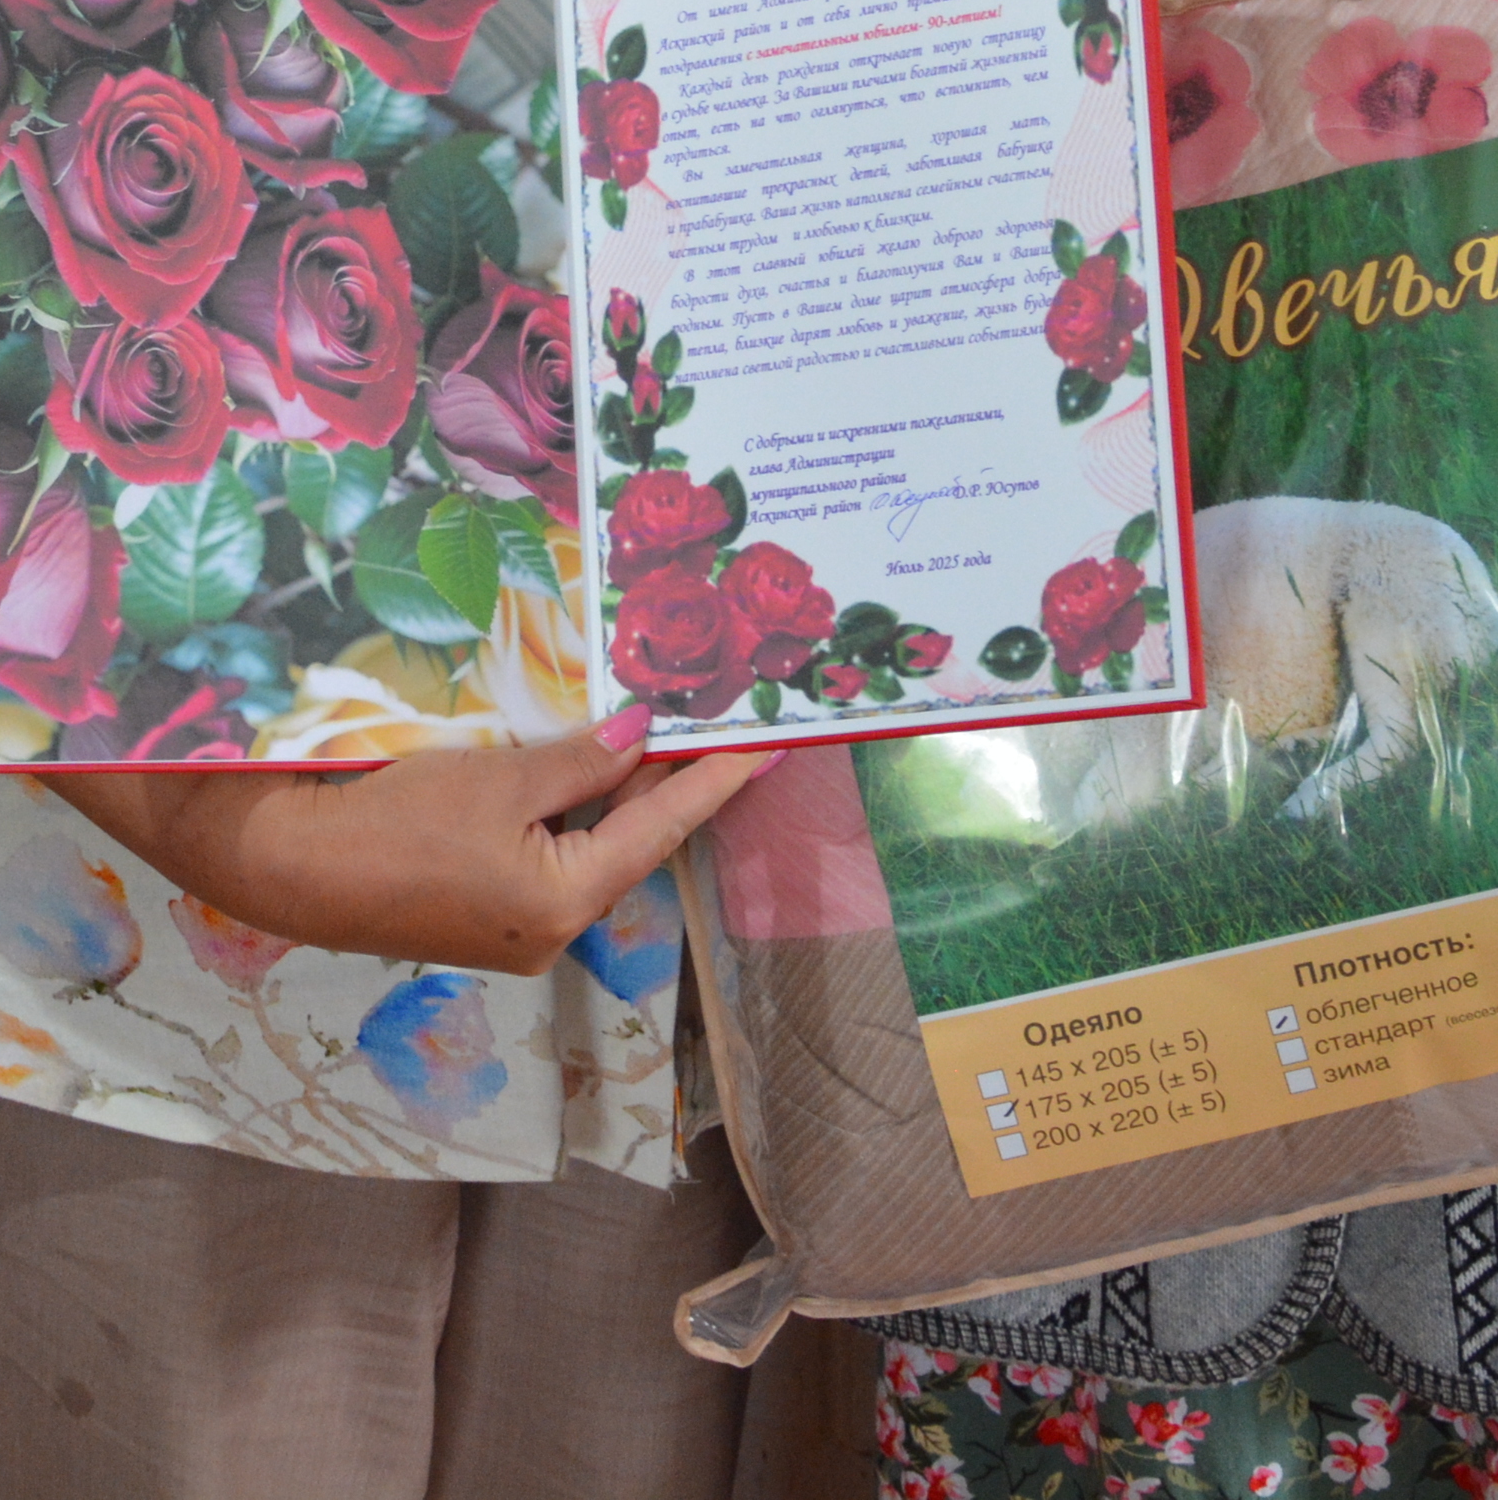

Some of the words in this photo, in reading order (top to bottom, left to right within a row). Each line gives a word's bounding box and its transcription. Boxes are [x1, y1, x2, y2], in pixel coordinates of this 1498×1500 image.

[656, 28, 724, 54] Аскинский
[733, 23, 770, 43] район
[780, 20, 787, 30] и
[796, 15, 814, 27] от
[823, 4, 850, 22] себя
[859, 1, 897, 16] лично
[677, 10, 697, 23] От
[709, 2, 747, 17] имени
[660, 53, 742, 76] поздравления
[746, 51, 752, 60] с
[756, 33, 859, 59] замечательным
[927, 5, 1001, 29] 90-летием!
[744, 438, 754, 452] С
[756, 432, 814, 452] добрыми
[817, 432, 825, 441] и
[828, 421, 906, 442] искренними
[910, 409, 1004, 430] пожеланиями,
[749, 462, 782, 476] глава
[784, 449, 895, 473] Администрации
[749, 479, 857, 505] муниципального
[860, 472, 906, 492] района
[985, 480, 1039, 498] Юсупов
[747, 503, 817, 526] Аскинский
[822, 500, 861, 519] район
[885, 560, 924, 576] Июль
[927, 554, 959, 571] 2025
[963, 550, 991, 567] года
[1294, 933, 1474, 987] Плотность:
[1306, 972, 1478, 1024] облегченное
[1023, 1007, 1142, 1046] Одеяло
[1315, 1015, 1435, 1054] стандарт
[1016, 1060, 1063, 1087] 145
[1092, 1043, 1141, 1071] 205
[1149, 1038, 1176, 1063] (±
[1183, 1028, 1208, 1053] 5)
[1323, 1056, 1391, 1082] зима
[1025, 1092, 1072, 1118] 175
[1101, 1075, 1150, 1102] 205
[1159, 1070, 1185, 1094] (±
[1192, 1059, 1217, 1083] 5)
[1033, 1123, 1080, 1149] 200
[1110, 1105, 1158, 1132] 220
[1167, 1100, 1193, 1123] (±
[1201, 1089, 1226, 1113] 5)
